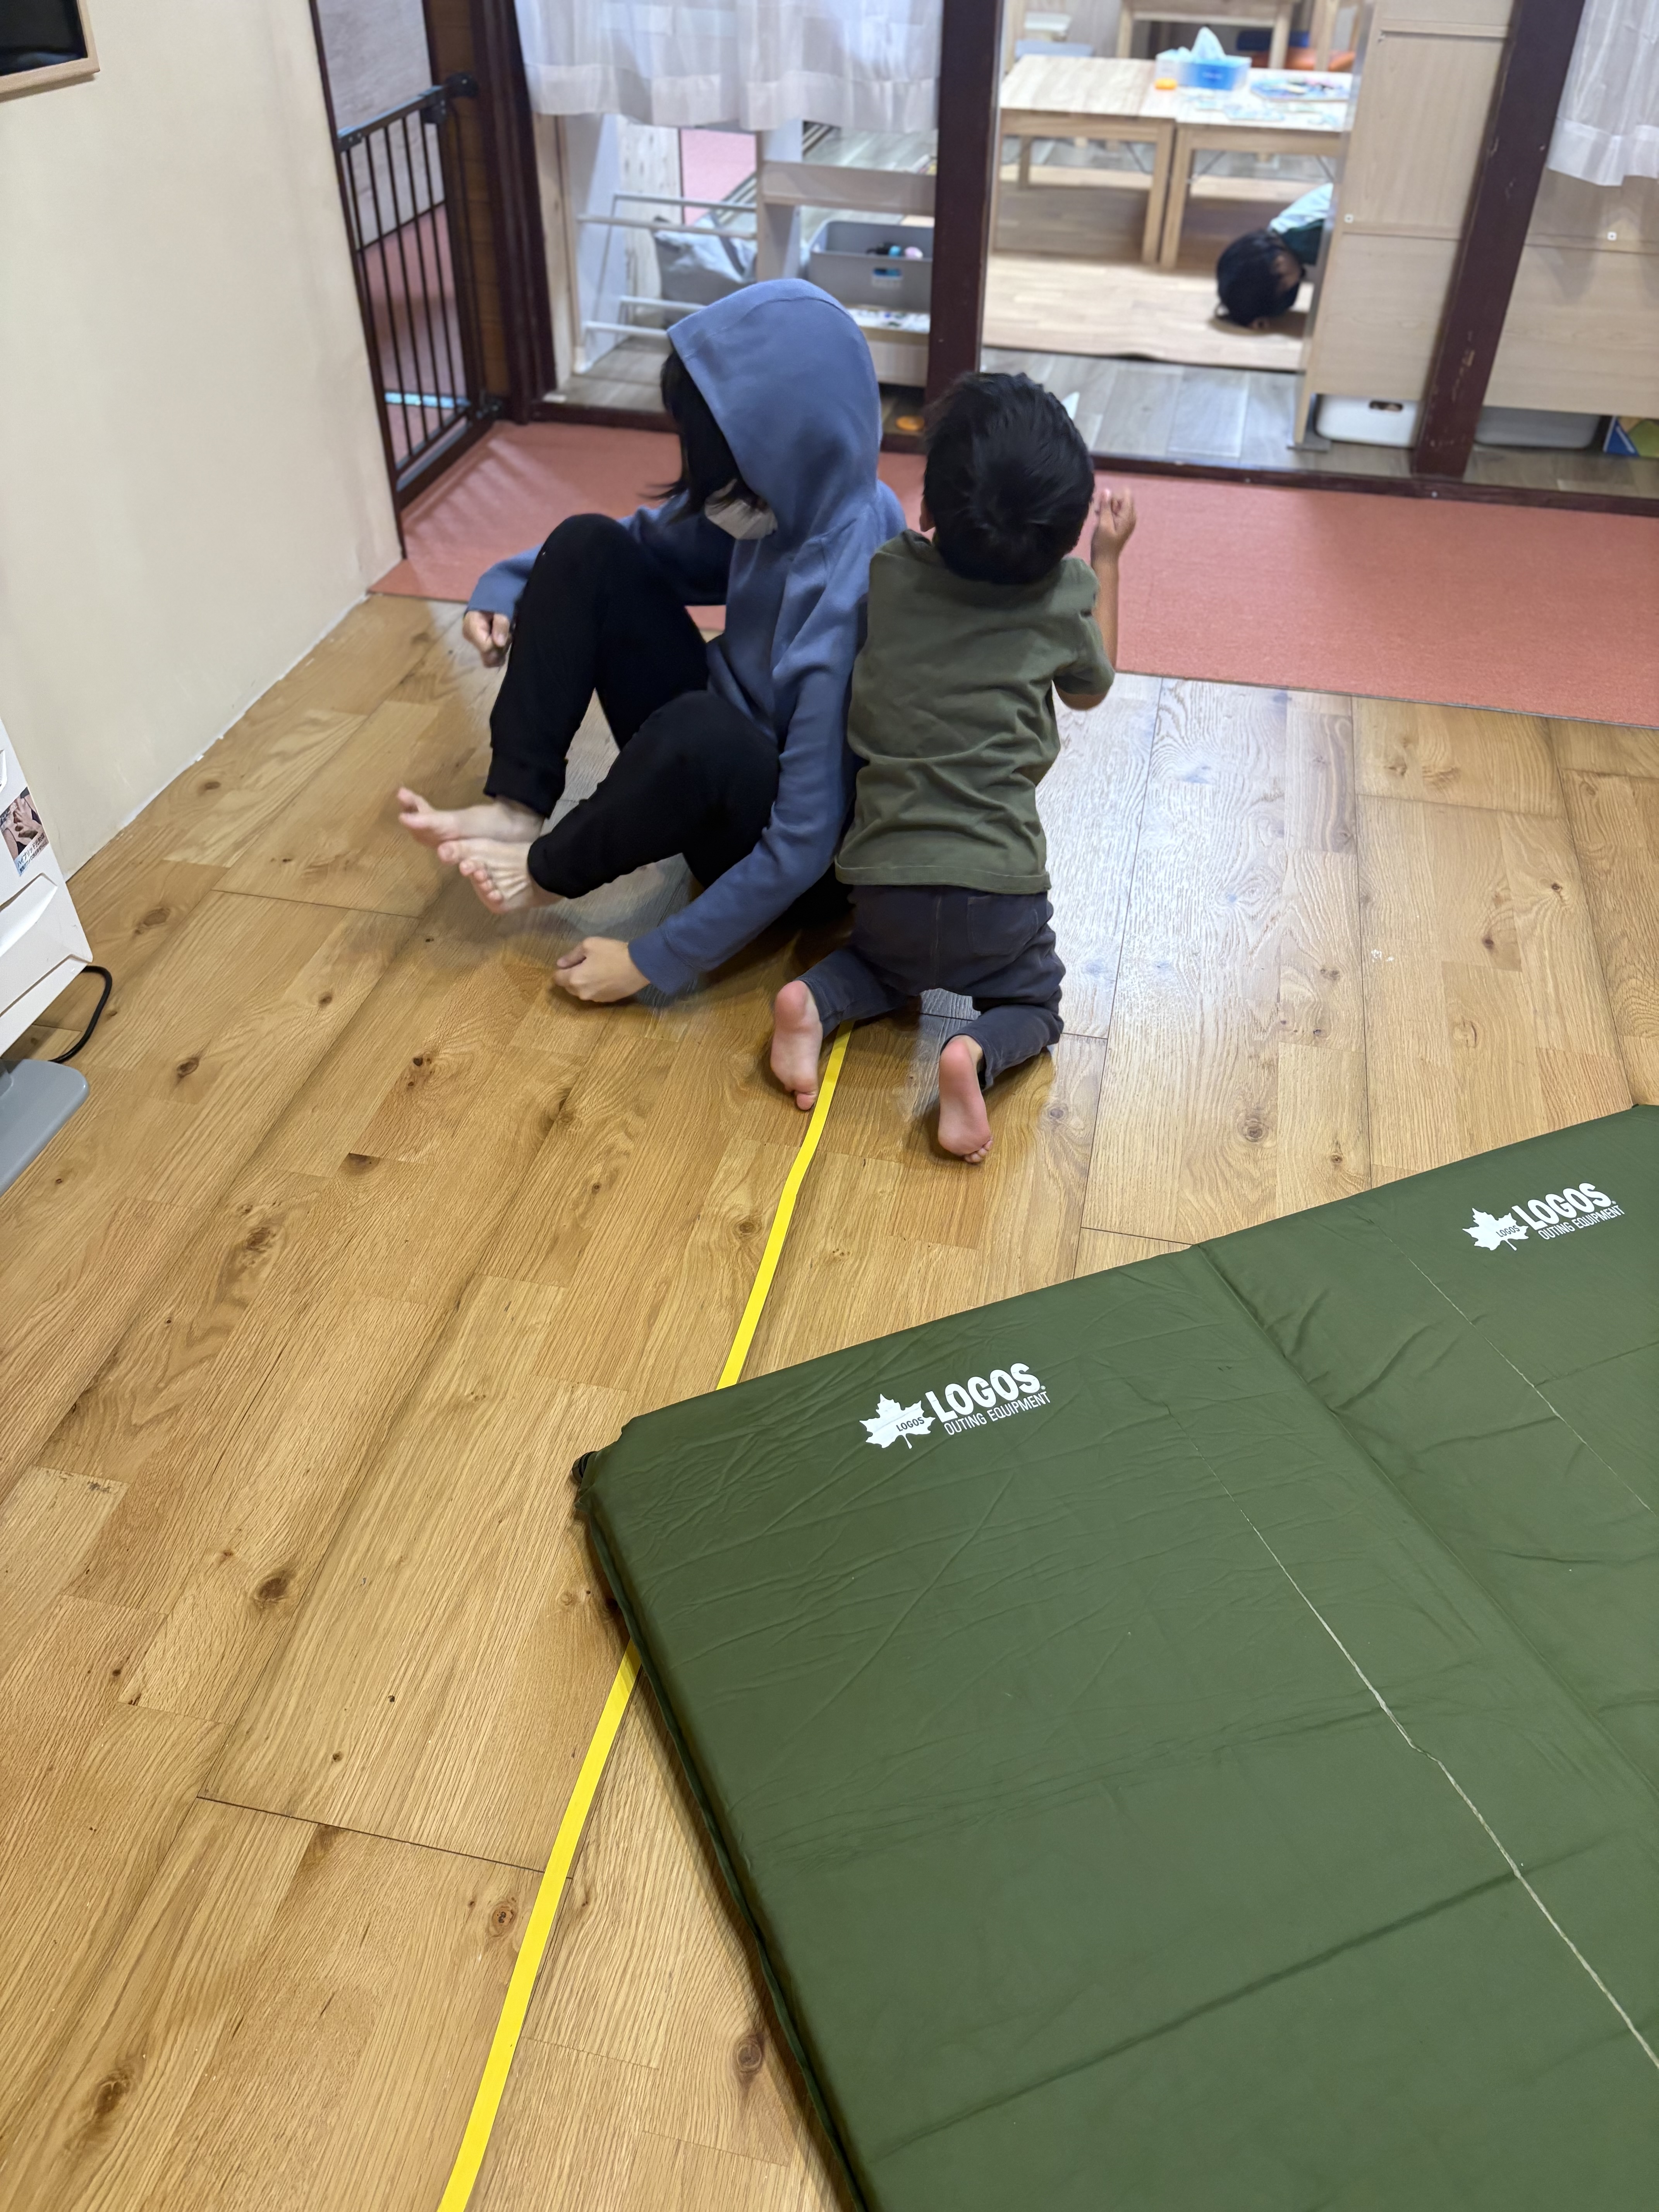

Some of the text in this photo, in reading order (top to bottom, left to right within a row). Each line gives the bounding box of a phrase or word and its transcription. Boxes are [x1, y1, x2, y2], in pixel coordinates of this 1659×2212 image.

[1511, 1183, 1611, 1230] LOGOS
[1538, 1205, 1625, 1240] OUTING EQUIPMENT
[1495, 1225, 1520, 1238] LOGOS
[925, 1363, 1040, 1423] LOGOS
[895, 1416, 925, 1432] LOGOS
[944, 1391, 1051, 1436] OUTING EQUIPMENT
